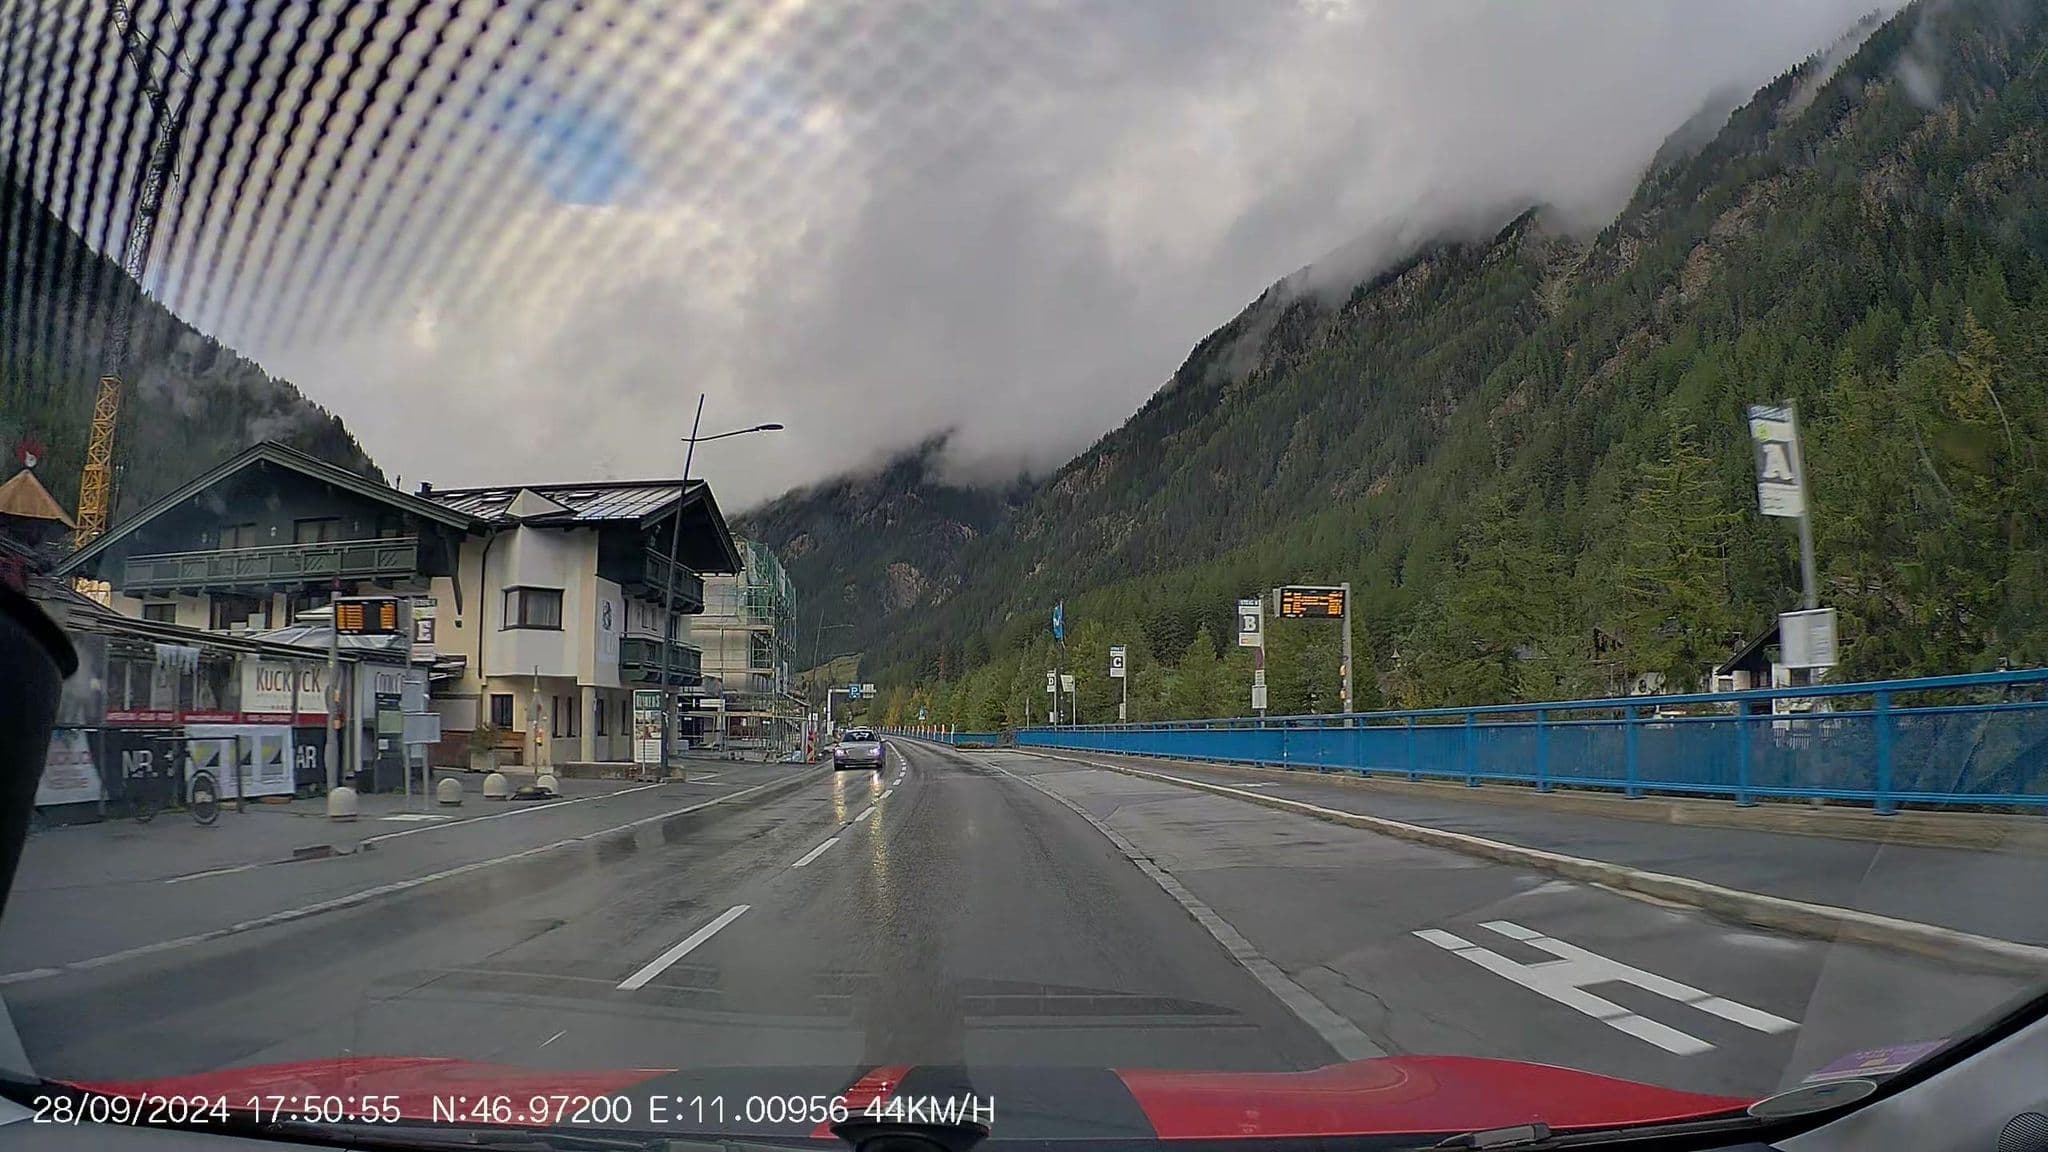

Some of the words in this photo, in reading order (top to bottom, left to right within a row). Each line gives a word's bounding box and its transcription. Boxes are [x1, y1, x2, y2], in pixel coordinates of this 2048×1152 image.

[1762, 443, 1793, 480] A
[417, 620, 431, 641] E
[1243, 615, 1256, 631] B
[1113, 657, 1121, 667] C
[256, 667, 321, 693] KUCKCK
[1410, 919, 1803, 1057] H
